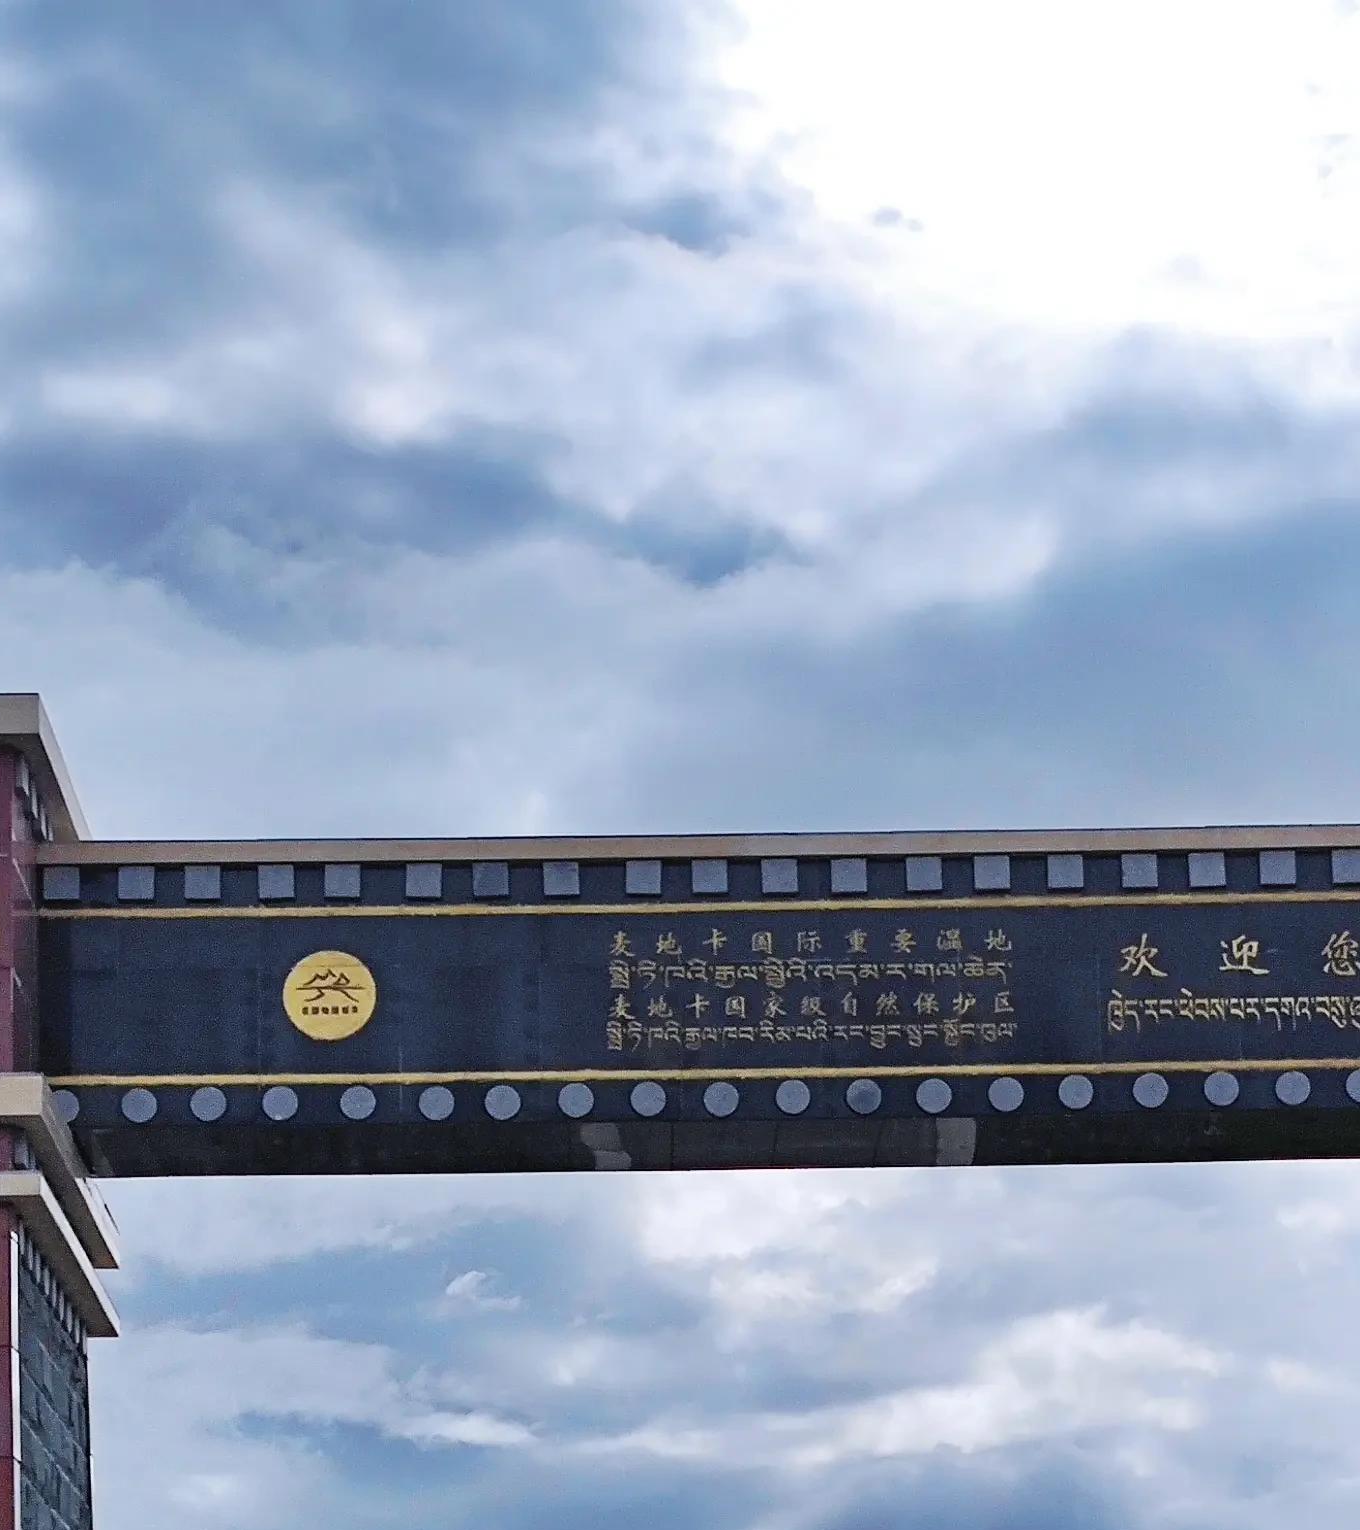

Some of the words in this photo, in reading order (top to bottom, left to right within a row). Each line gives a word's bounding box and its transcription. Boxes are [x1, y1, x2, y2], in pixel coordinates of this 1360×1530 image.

[610, 929, 1012, 957] 麦地卡国际重要湿地
[609, 991, 1014, 1018] 麦地卡国家级自然保护区
